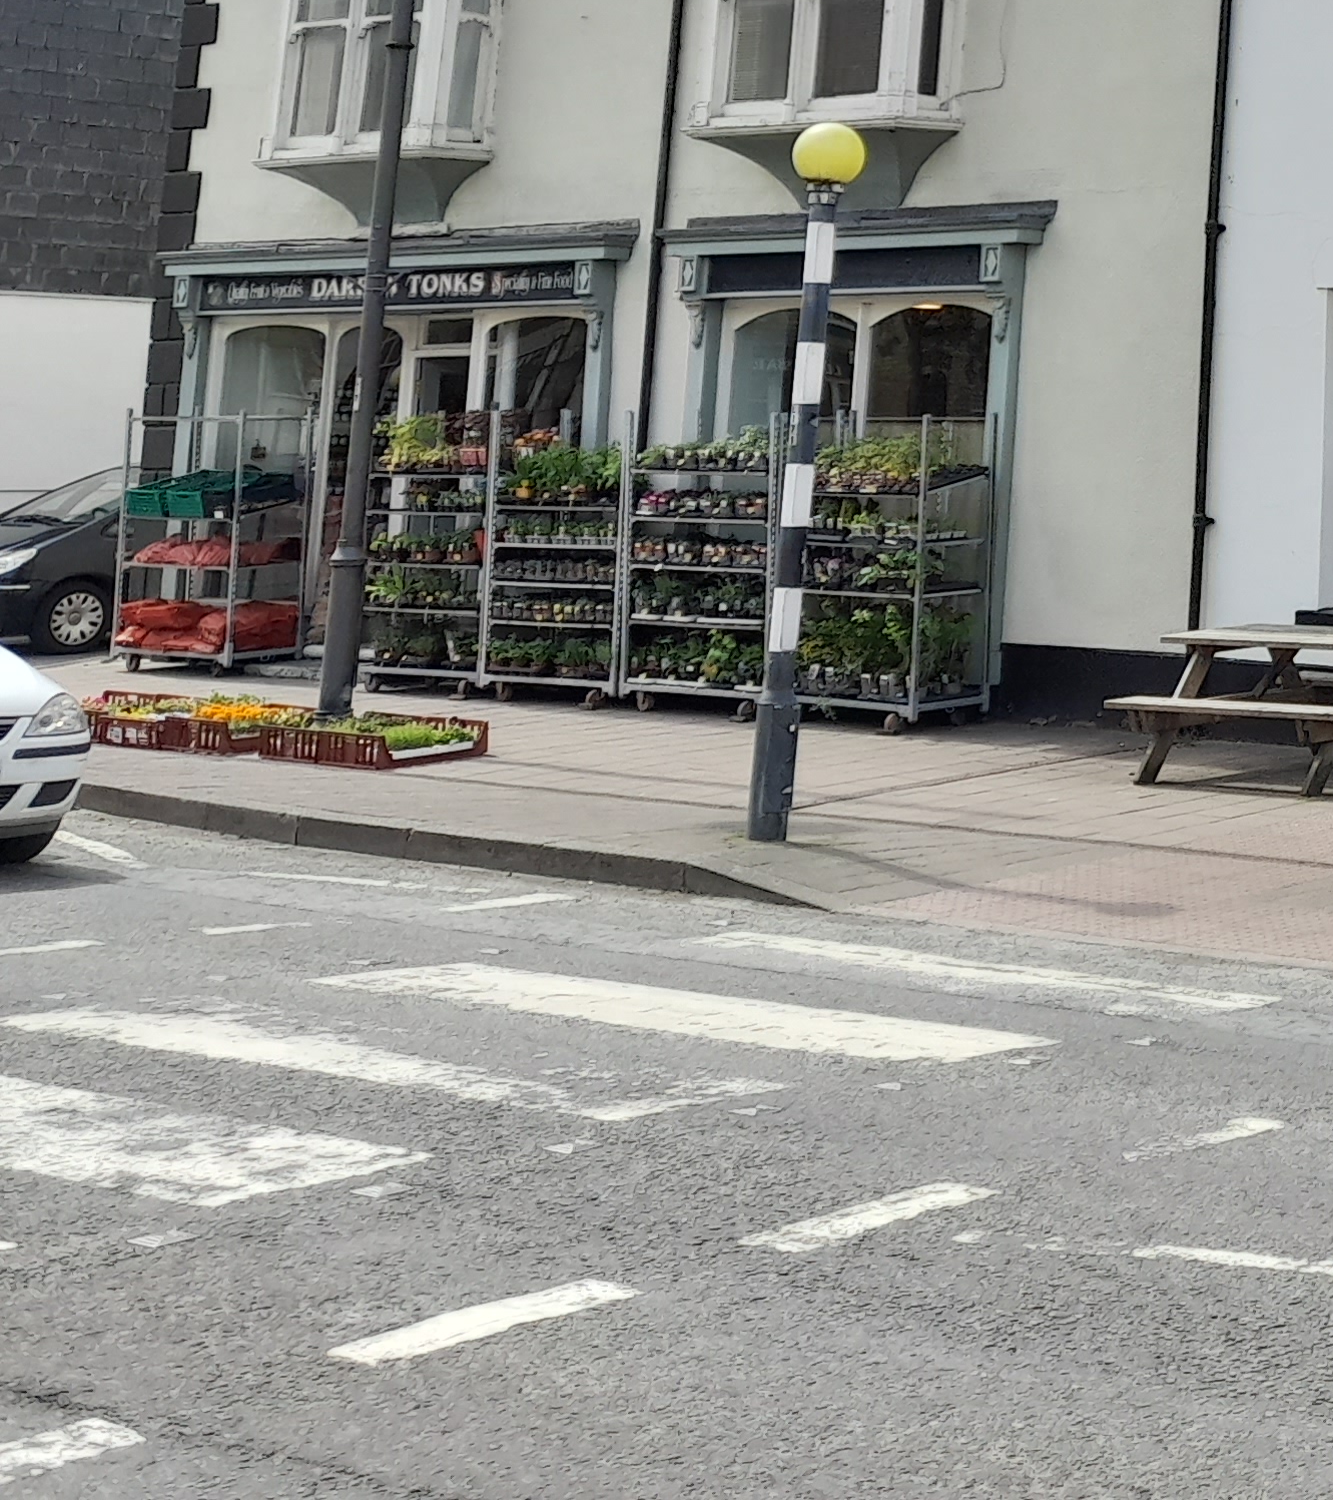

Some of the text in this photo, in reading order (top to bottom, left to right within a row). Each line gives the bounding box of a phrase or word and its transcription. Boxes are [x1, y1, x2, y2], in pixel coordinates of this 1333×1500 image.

[309, 272, 485, 300] DARSN TONKS
[553, 268, 573, 289] Food
